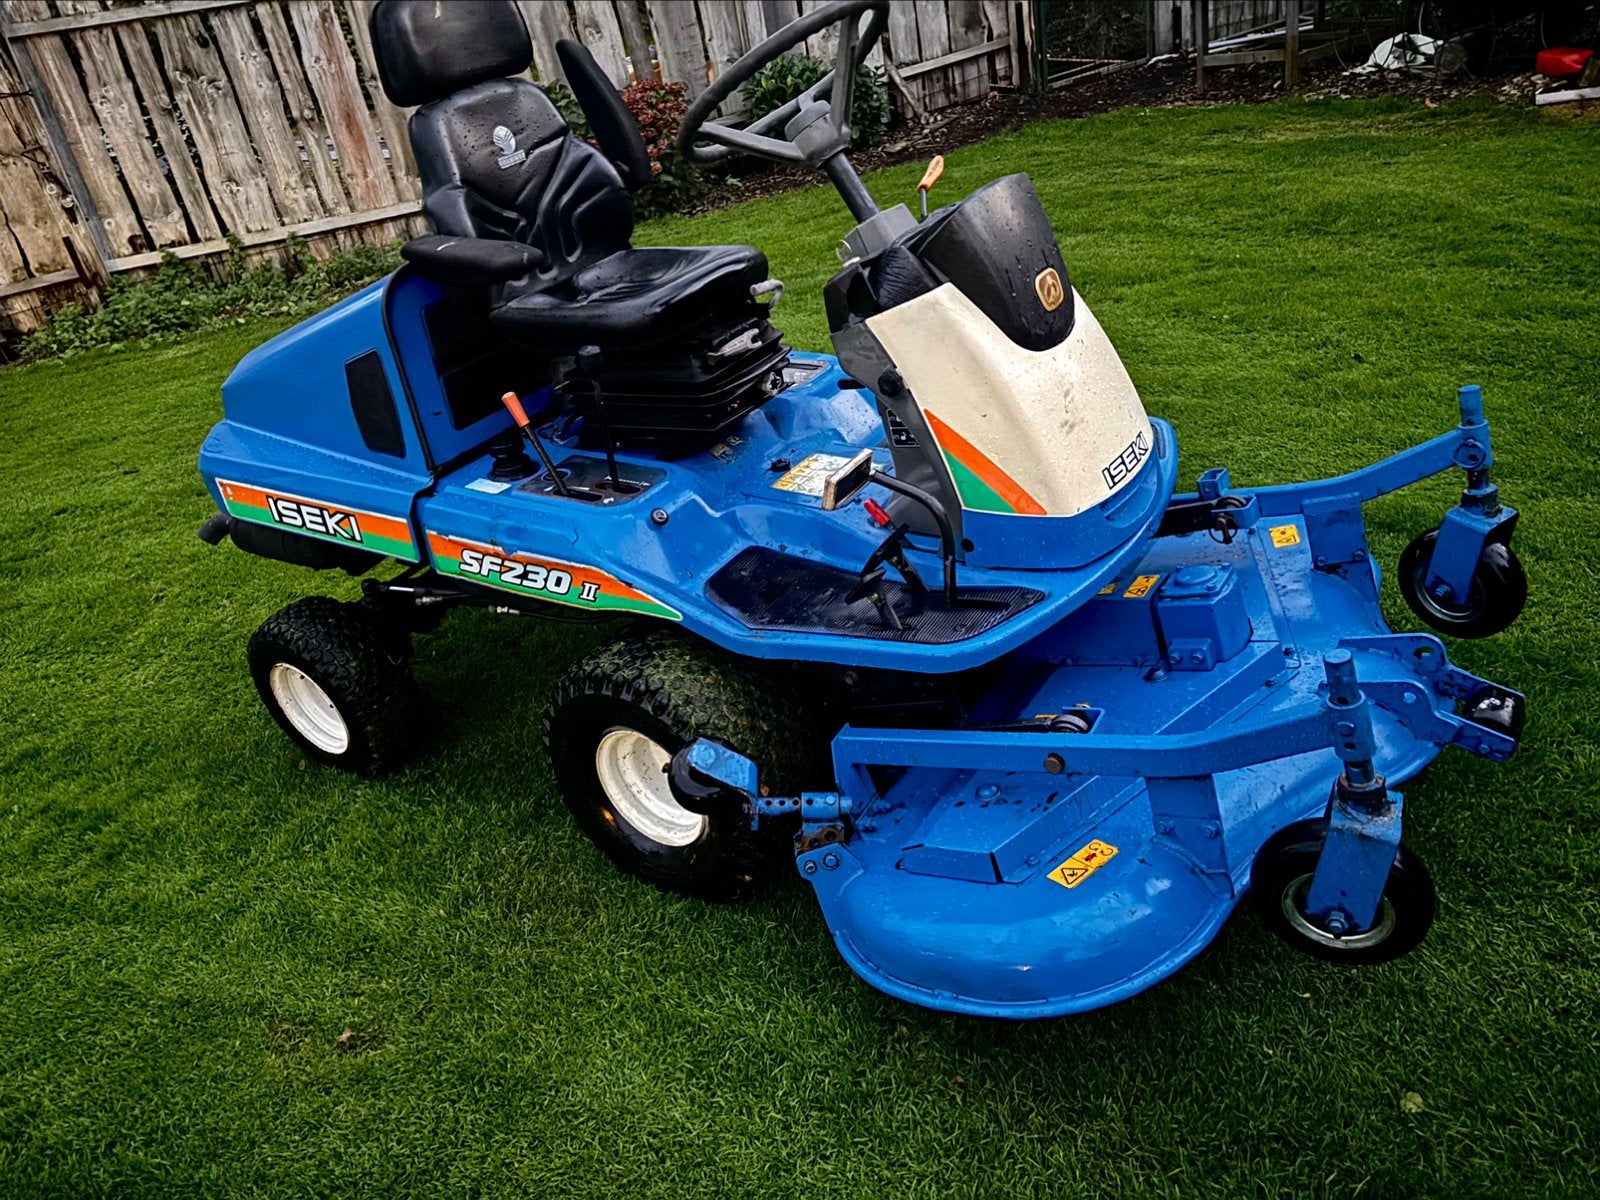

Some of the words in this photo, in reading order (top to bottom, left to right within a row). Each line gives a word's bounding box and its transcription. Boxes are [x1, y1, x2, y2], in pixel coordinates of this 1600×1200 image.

[1102, 431, 1149, 490] ISEKI
[266, 495, 364, 544] ISEKI
[459, 549, 572, 595] SF230
